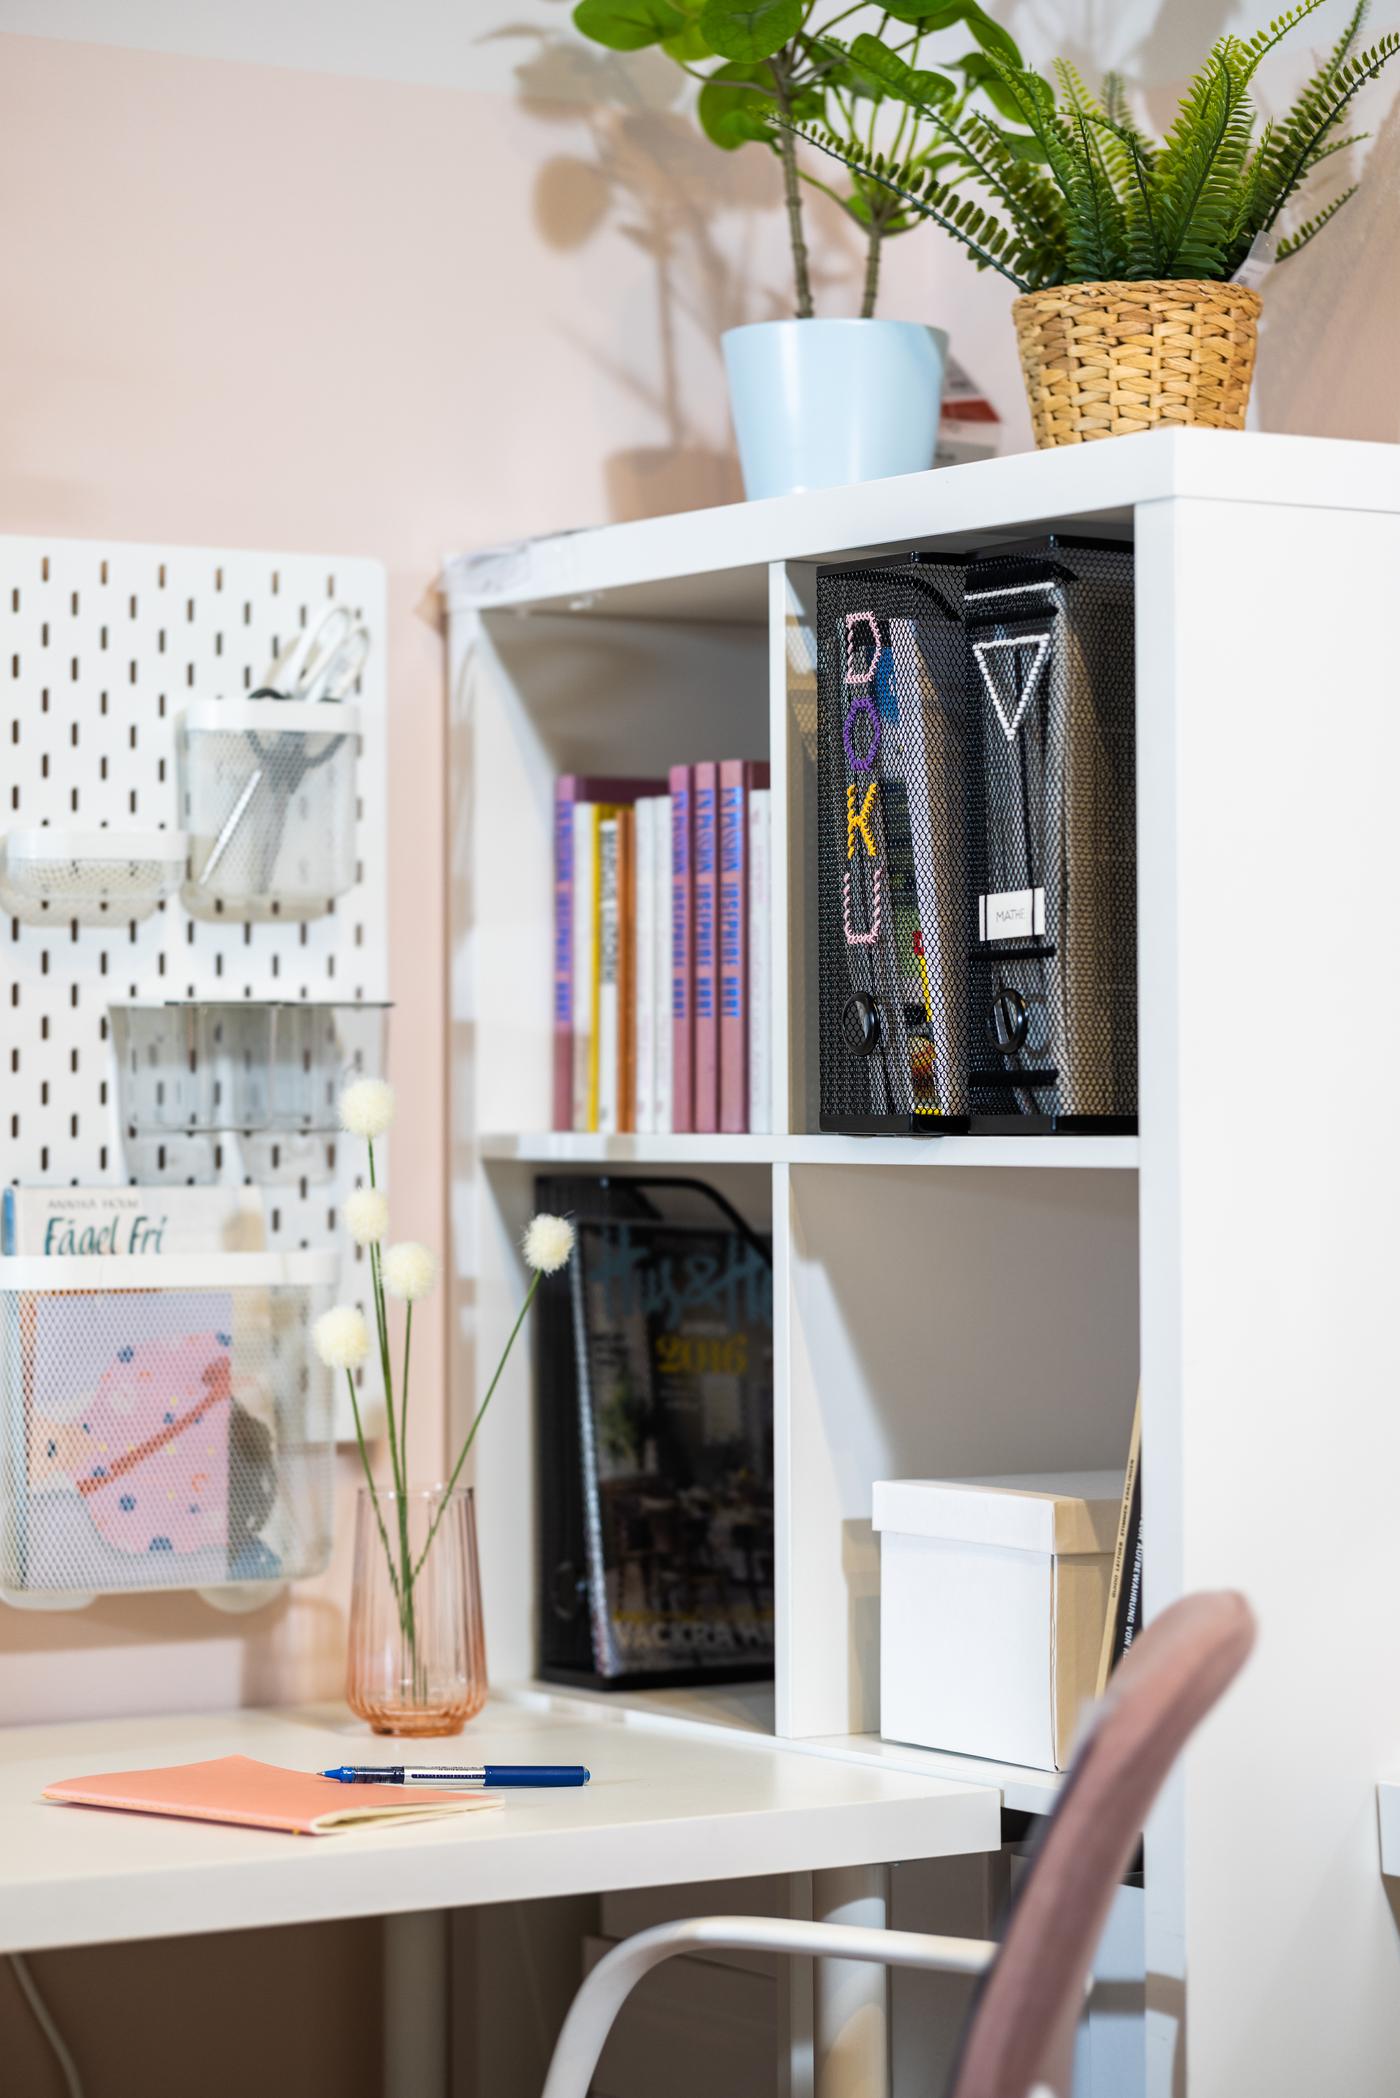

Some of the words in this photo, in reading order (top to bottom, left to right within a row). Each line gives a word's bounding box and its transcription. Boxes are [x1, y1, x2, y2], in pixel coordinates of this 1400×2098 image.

[995, 908, 1025, 923] MATHE
[128, 1215, 168, 1255] Fri
[655, 1332, 748, 1376] 2016
[1123, 1626, 1134, 1647] VON
